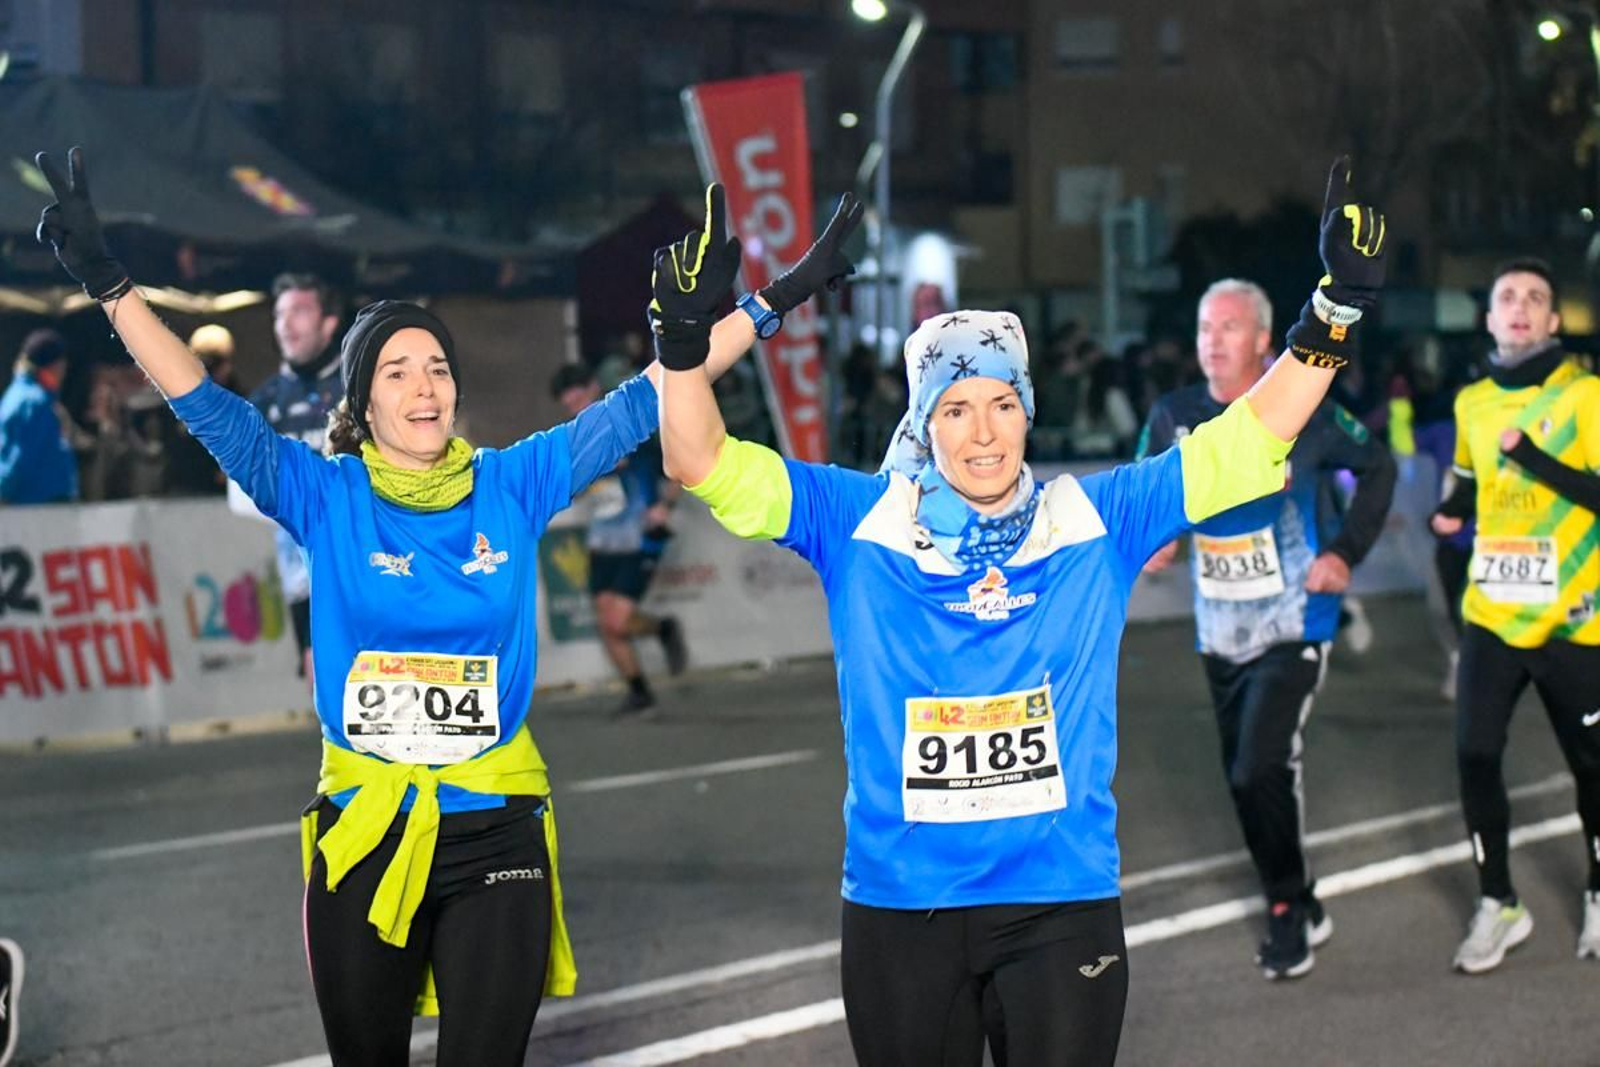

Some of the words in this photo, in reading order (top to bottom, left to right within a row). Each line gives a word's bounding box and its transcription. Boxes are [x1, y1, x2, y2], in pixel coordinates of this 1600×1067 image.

[0, 546, 41, 615] 2
[42, 541, 159, 618] SAN
[1484, 556, 1548, 581] 7687
[379, 657, 405, 674] 42
[358, 684, 484, 723] 9204
[940, 705, 965, 725] 42
[918, 726, 1047, 774] 9185
